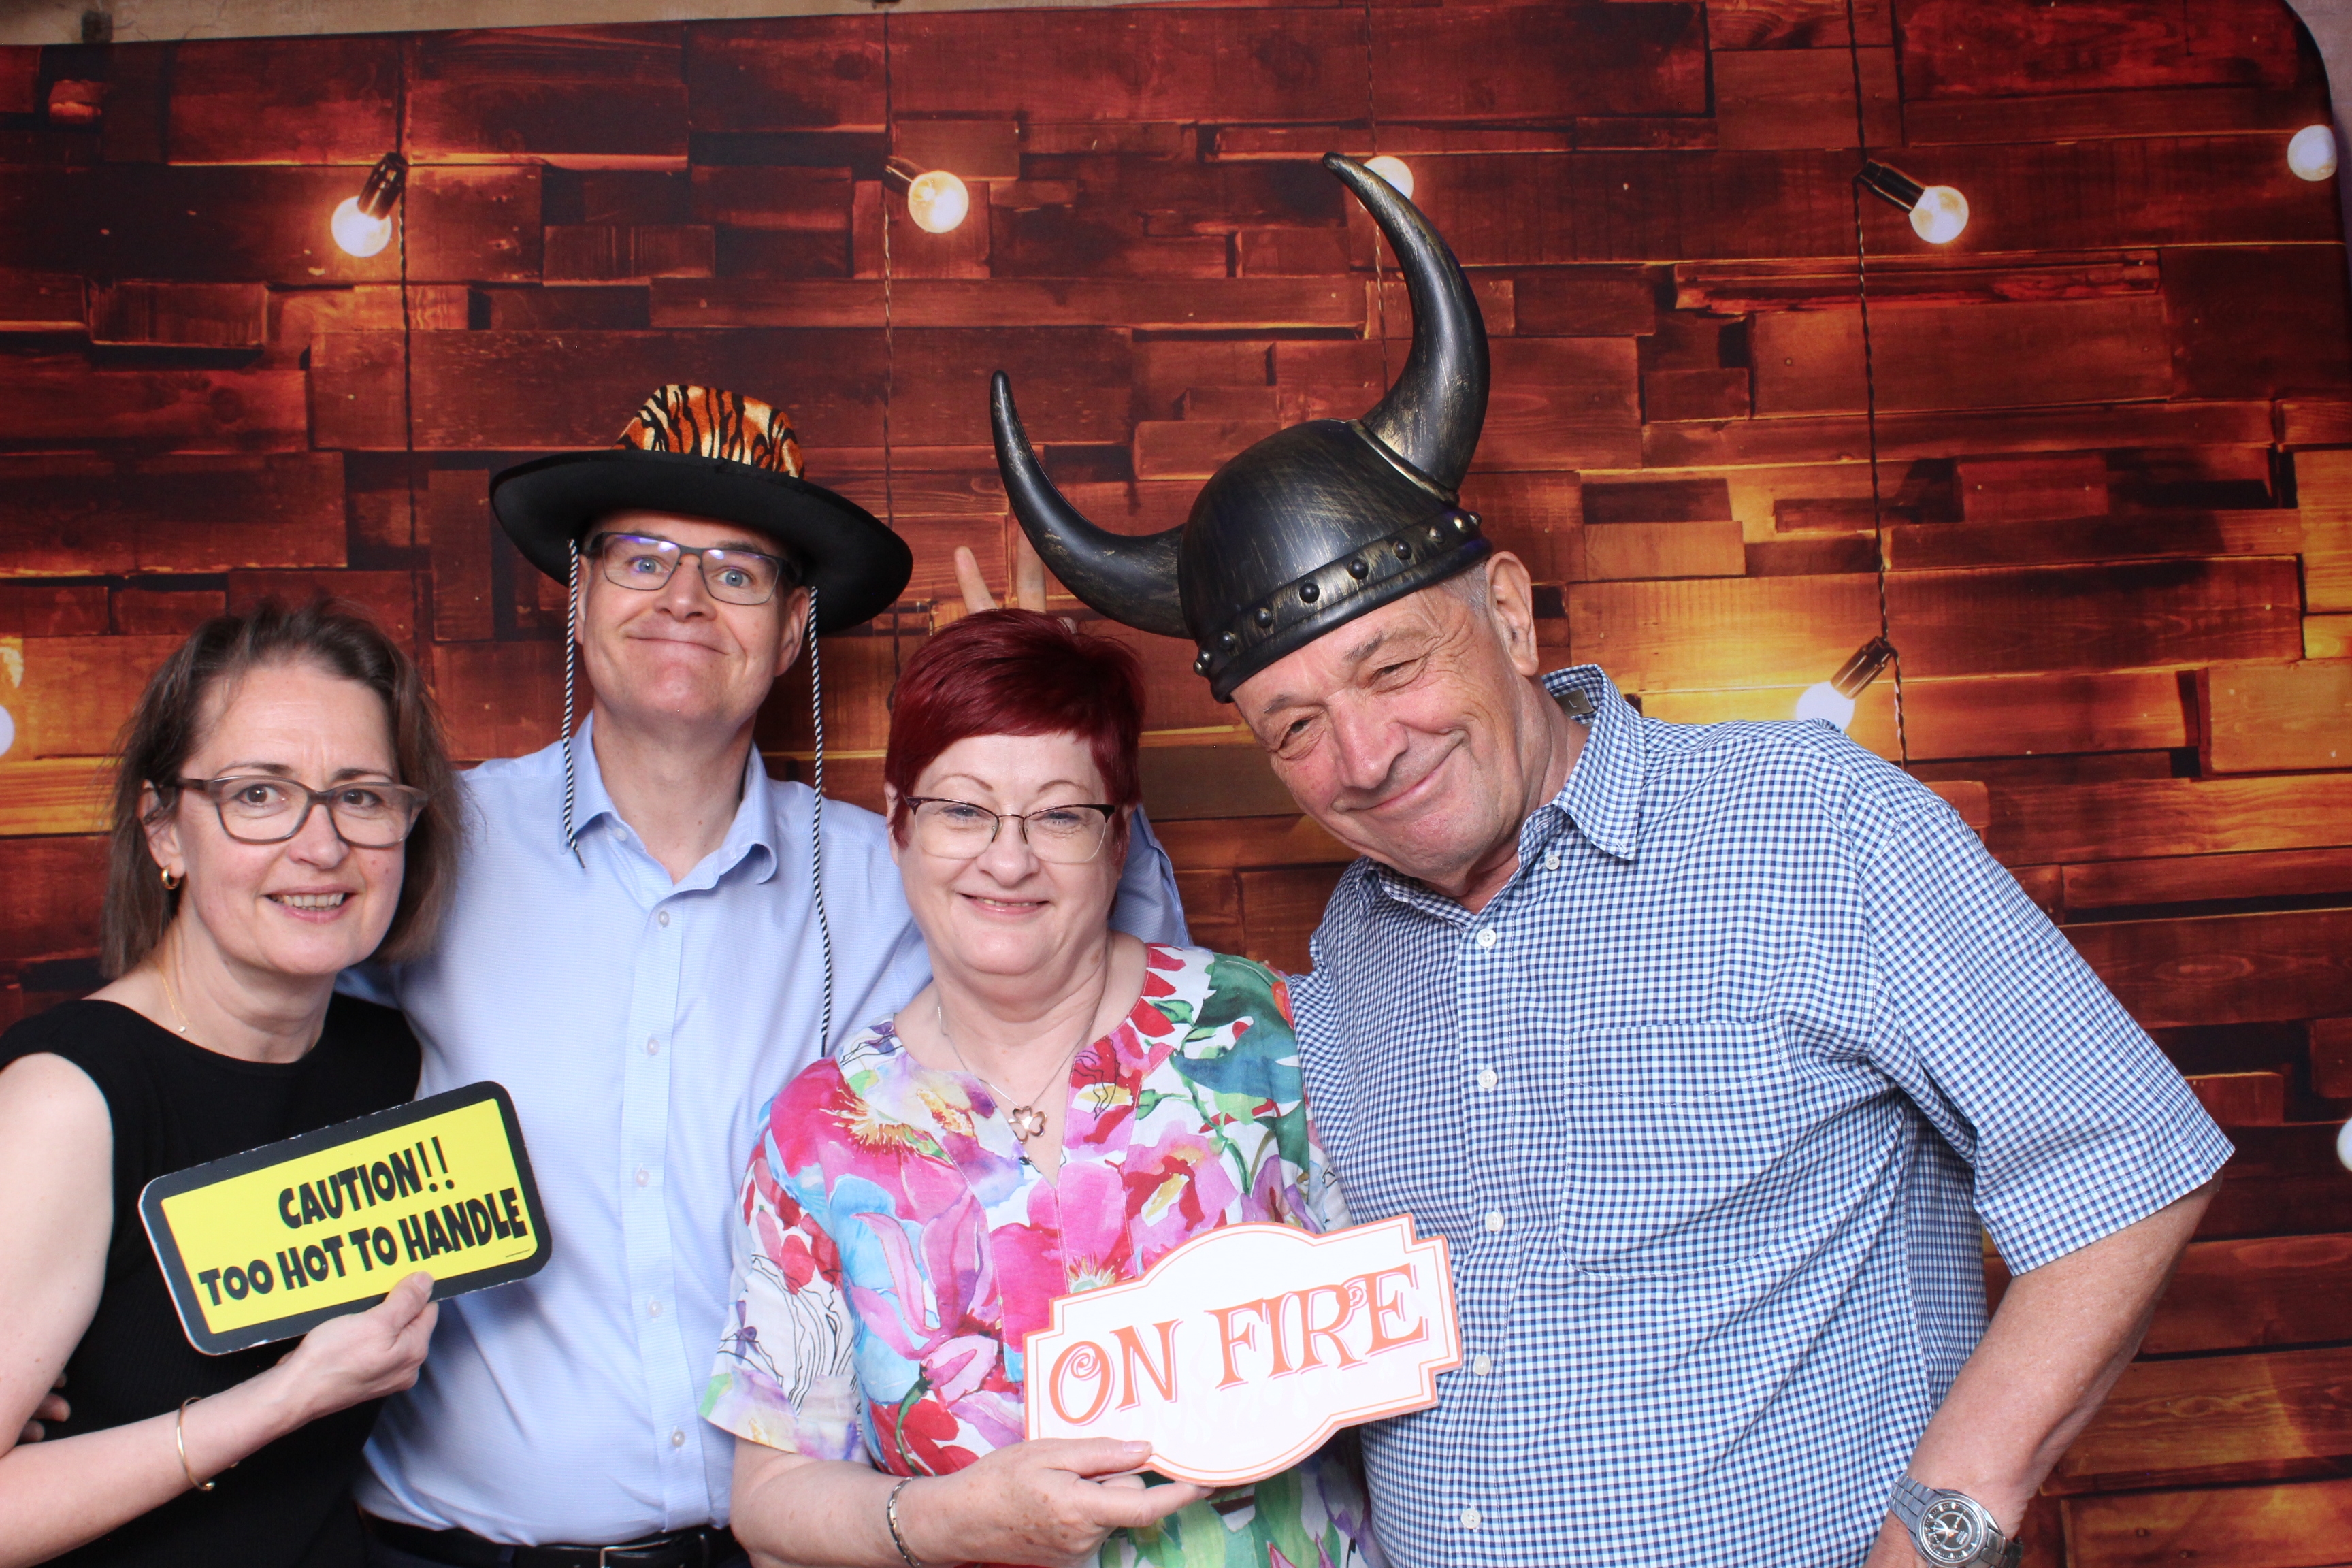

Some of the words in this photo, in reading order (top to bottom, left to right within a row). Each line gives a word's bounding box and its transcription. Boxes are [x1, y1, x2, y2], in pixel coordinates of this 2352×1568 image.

[1569, 700, 1578, 708] L
[278, 1136, 455, 1229] CAUTION!!
[198, 1259, 274, 1307] TOO
[276, 1236, 346, 1290] HOT
[348, 1226, 398, 1272] TO
[398, 1188, 528, 1263] HANDLE
[1049, 1318, 1183, 1426] ON
[1203, 1263, 1430, 1391] FIRE
